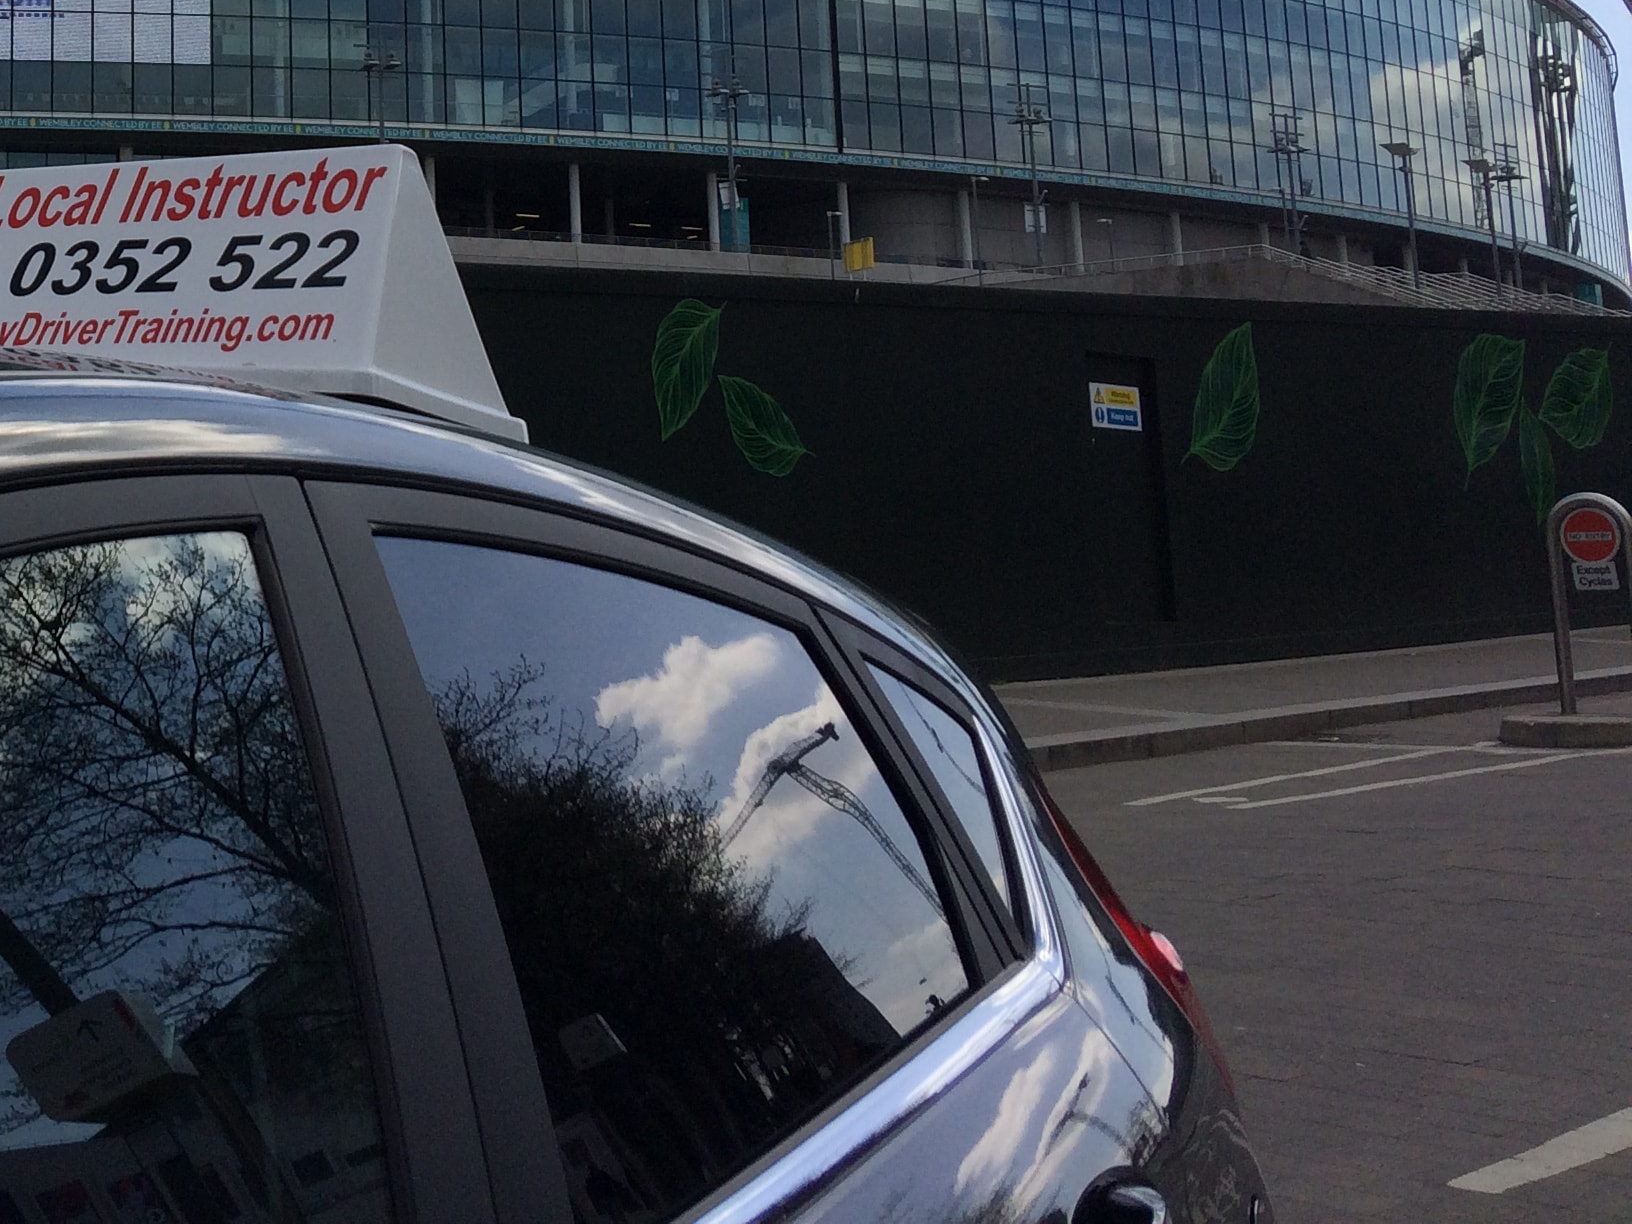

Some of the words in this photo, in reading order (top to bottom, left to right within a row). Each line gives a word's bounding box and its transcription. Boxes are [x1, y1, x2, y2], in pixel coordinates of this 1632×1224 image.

[39, 118, 82, 127] WEMBLEY
[83, 119, 137, 128] CONNECTED
[172, 121, 215, 130] WEMBLEY
[216, 122, 269, 132] CONNECTED
[305, 125, 346, 134] WEMBLEY
[346, 127, 398, 136] CONNETED
[432, 130, 473, 140] WEMBLEY
[473, 132, 524, 142] CONNECTED
[557, 136, 596, 146] WEMBLEY
[596, 138, 645, 149] CONNECTED
[118, 156, 388, 224] Instructor
[9, 236, 192, 297] 0352
[209, 229, 360, 292] 522
[1576, 565, 1612, 576] Except
[1579, 577, 1614, 587] Cycles
